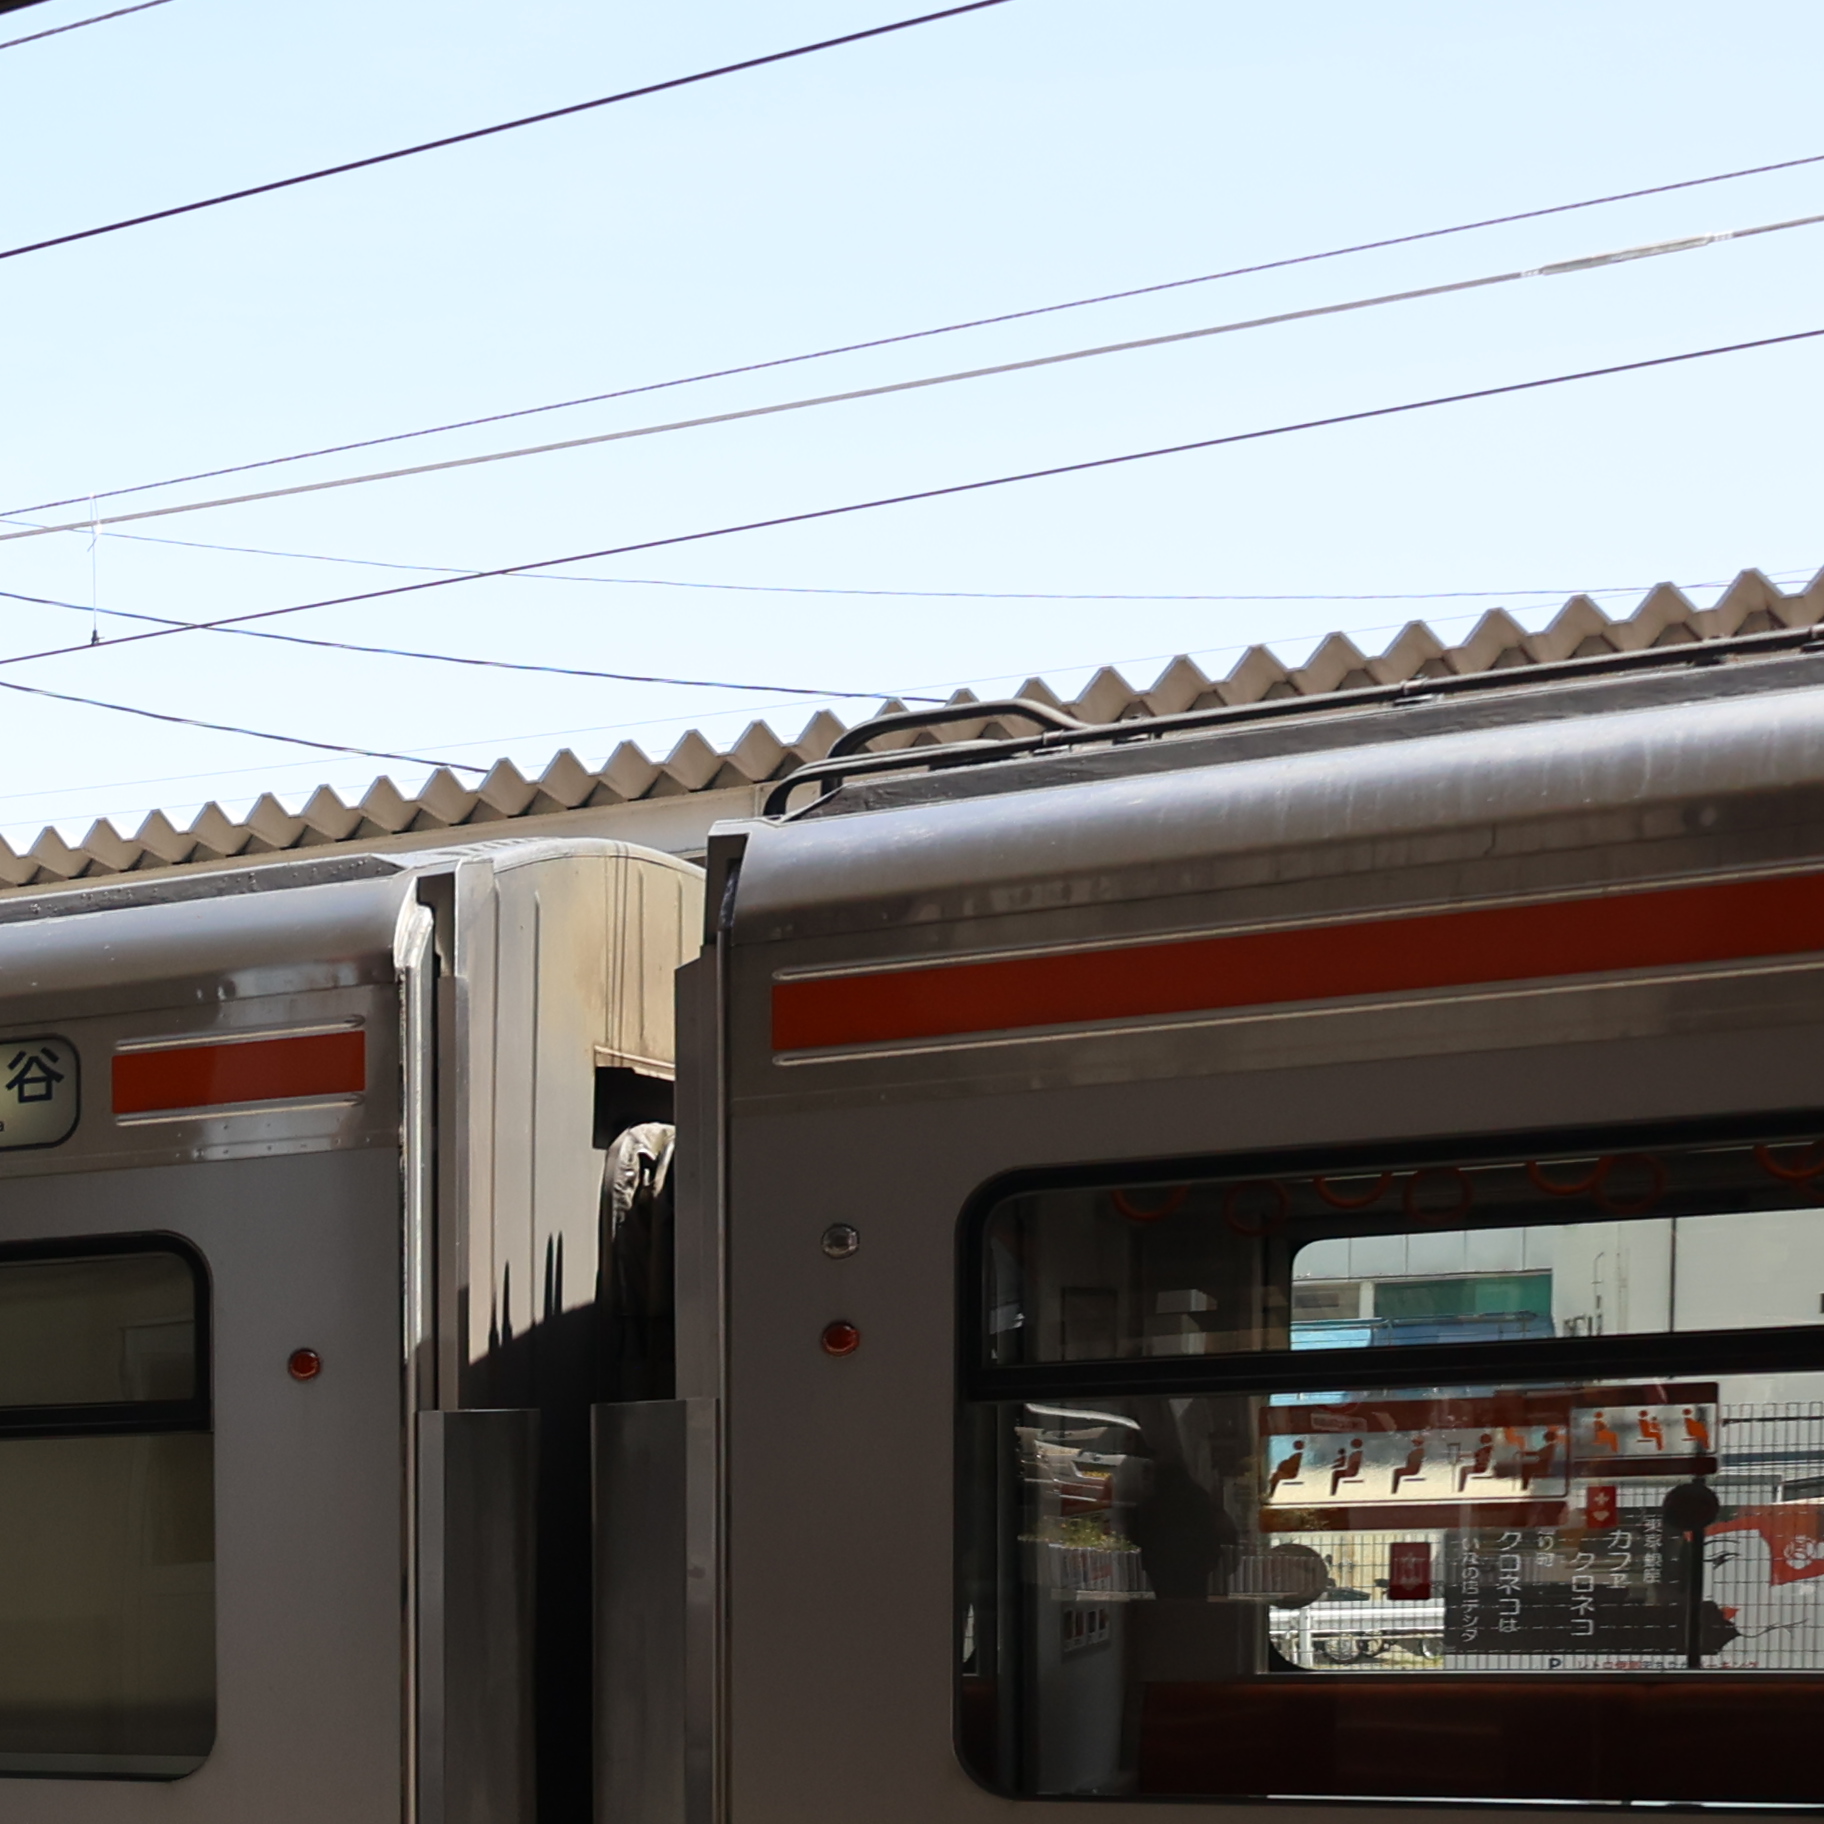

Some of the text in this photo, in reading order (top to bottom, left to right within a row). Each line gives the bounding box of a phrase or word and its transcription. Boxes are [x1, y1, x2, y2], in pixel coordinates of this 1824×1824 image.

[1497, 1531, 1522, 1633] クロネコは
[1570, 1552, 1595, 1636] クロネコ
